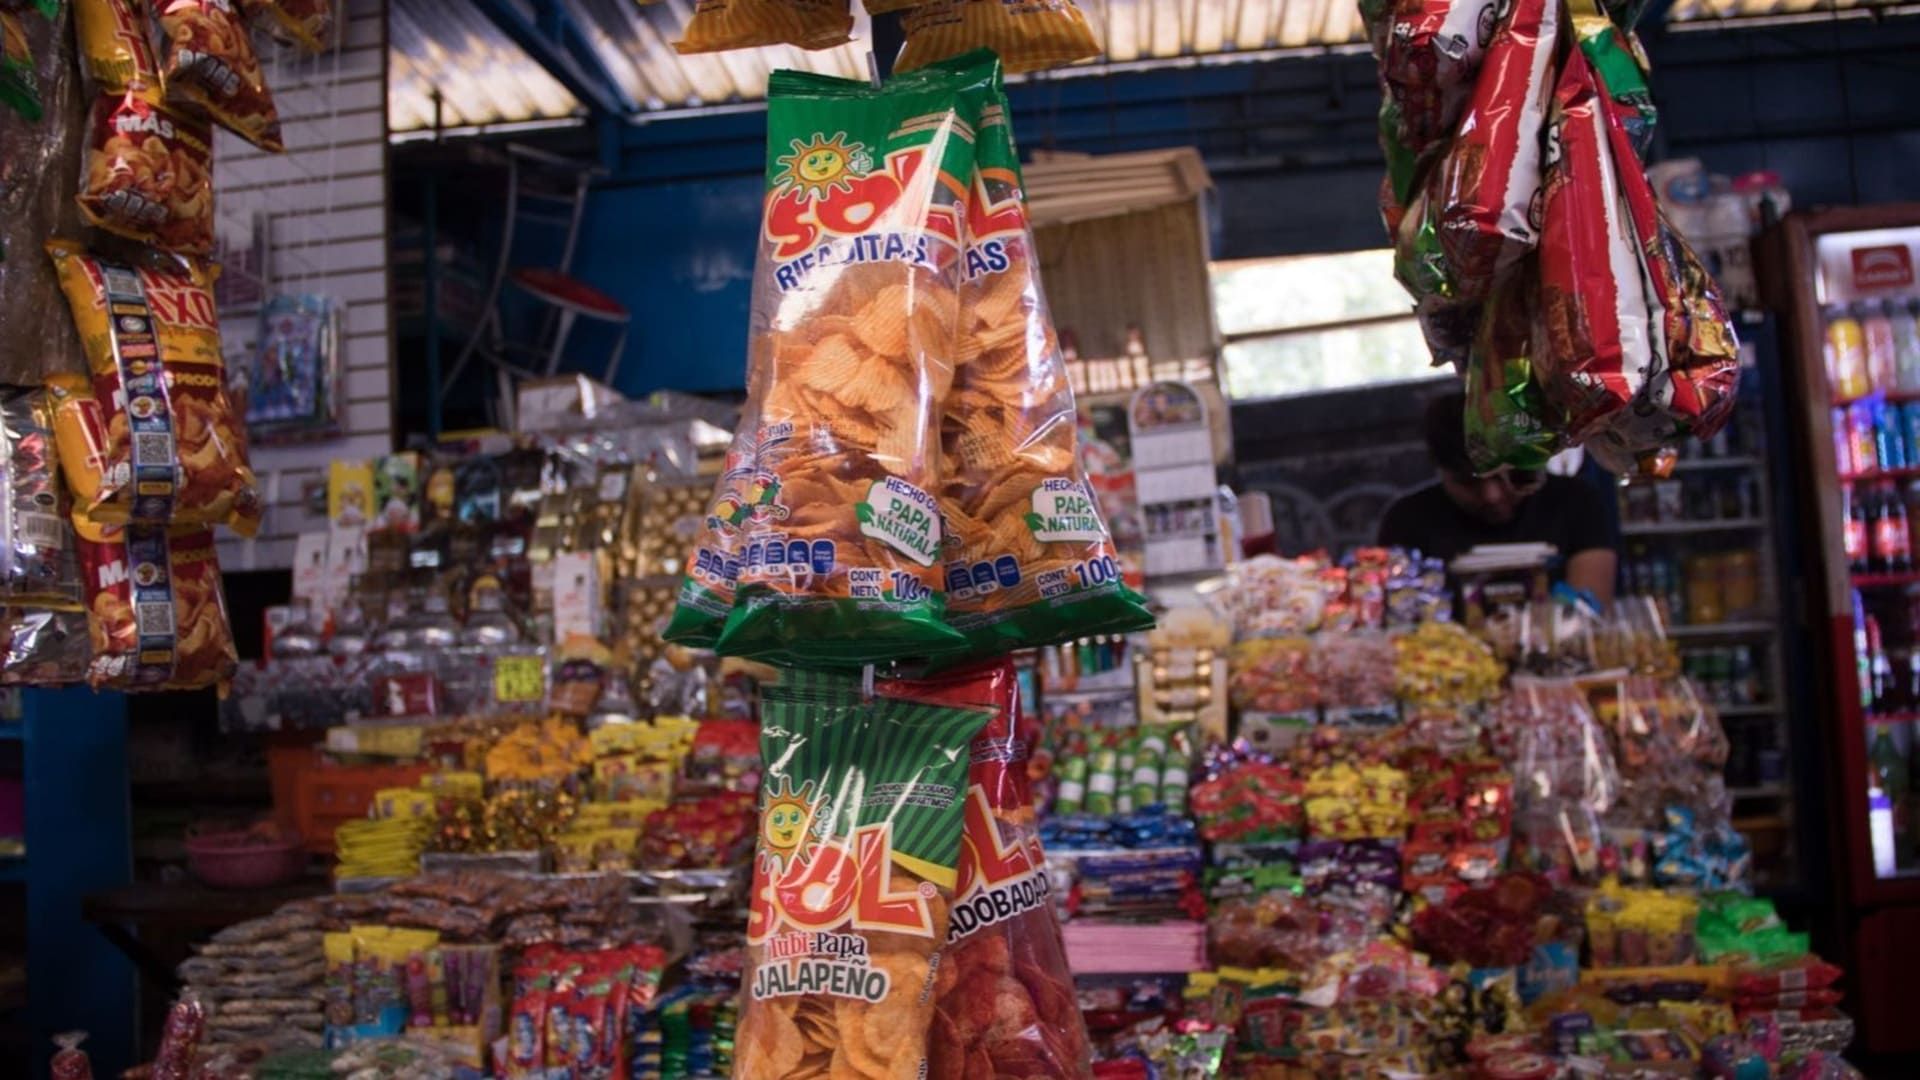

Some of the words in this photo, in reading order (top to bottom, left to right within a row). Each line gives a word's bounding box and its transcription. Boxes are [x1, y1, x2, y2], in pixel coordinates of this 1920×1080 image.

[885, 477, 926, 504] HECHO
[877, 514, 935, 553] NATURAL
[889, 497, 931, 537] PAPA
[850, 585, 881, 597] NETO
[748, 824, 933, 943] SOL
[752, 957, 888, 1002] JALAPEÑO
